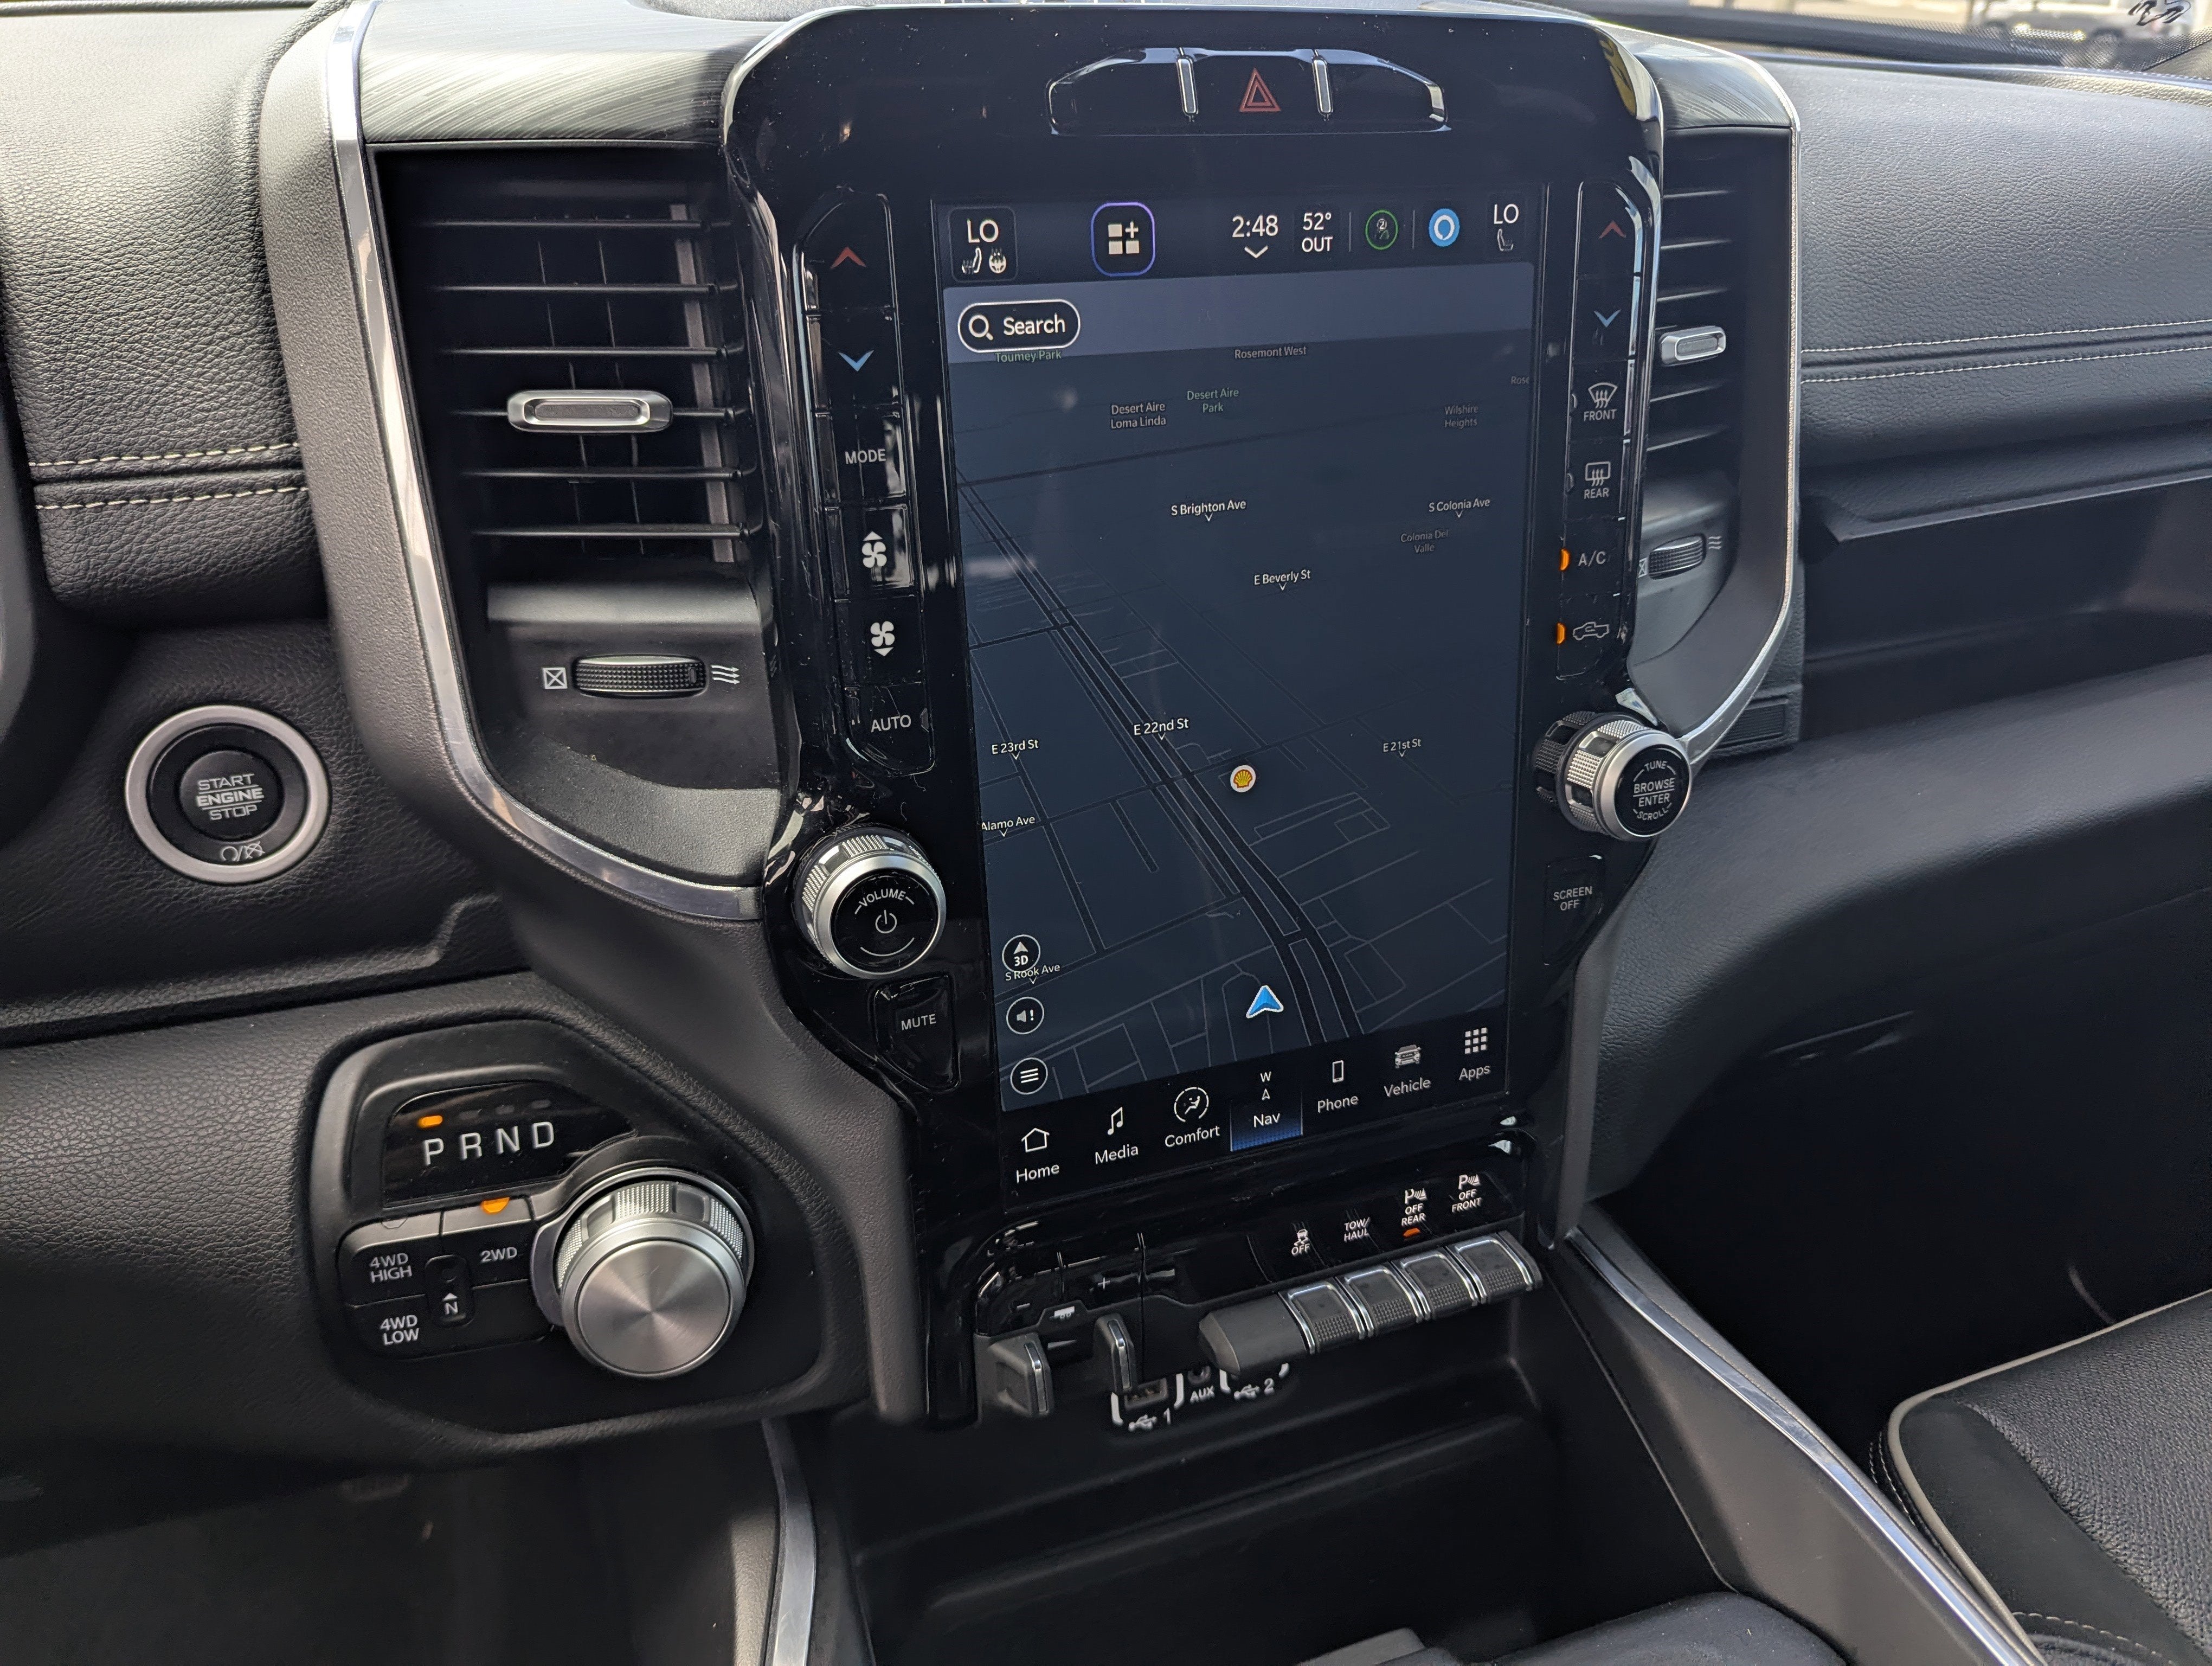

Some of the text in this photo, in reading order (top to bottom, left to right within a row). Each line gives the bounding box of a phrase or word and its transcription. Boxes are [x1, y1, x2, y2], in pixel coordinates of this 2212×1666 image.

[1494, 203, 1519, 224] LO
[967, 219, 999, 244] LO
[1232, 214, 1279, 238] 2:48
[1301, 236, 1333, 252] OUT
[1003, 313, 1066, 336] Search
[995, 349, 1062, 363] Toumey Park
[1234, 345, 1307, 360] Rosemont West
[1187, 388, 1239, 401] Desert Aire
[1111, 402, 1166, 415] Desert Aire
[1202, 402, 1224, 413] Park
[1444, 403, 1478, 415] Wilshire
[1583, 409, 1617, 422] FRONT
[1110, 415, 1166, 429] Loma Linda
[1444, 416, 1477, 429] Heights
[845, 448, 886, 464] MODE
[1584, 488, 1609, 499] REAR
[1171, 499, 1246, 516] S Brighton Ave
[1429, 497, 1490, 512] S Colonia Ave
[1400, 531, 1433, 543] Colonia
[1414, 543, 1435, 553] Valle
[1578, 550, 1606, 567] A/C
[1253, 569, 1311, 585] E Beverly St
[871, 714, 912, 733] AUTO
[1133, 717, 1189, 736] E 22nd St
[991, 739, 1039, 755] E 23rd St
[1382, 738, 1422, 752] E 21st St
[1644, 760, 1668, 771] TUNE
[198, 773, 254, 790] START
[1634, 777, 1675, 794] BROWSE
[196, 787, 265, 807] ENGINE
[1638, 793, 1670, 808] ENTER
[210, 804, 258, 821] STOP
[1636, 807, 1669, 821] SCROLL
[981, 815, 1035, 831] Alamo Ave
[858, 888, 906, 908] VOLUME
[1553, 886, 1592, 901] SCREEN
[1560, 899, 1579, 911] OFF
[1014, 955, 1028, 966] 3D
[1005, 964, 1060, 982] S Rook Ave
[901, 1014, 937, 1031] MUTE
[1260, 1071, 1272, 1082] W
[1459, 1065, 1491, 1081] Apps
[1384, 1078, 1431, 1098] Vehicle
[1317, 1094, 1359, 1113] Phone
[1253, 1112, 1281, 1128] Nav
[423, 1121, 555, 1165] P R N D
[1165, 1125, 1220, 1148] Comfort
[1095, 1144, 1139, 1164] Media
[1015, 1163, 1060, 1183] Home
[1458, 1189, 1477, 1201] OFF
[1405, 1203, 1424, 1215] OFF
[1451, 1197, 1483, 1213] FRONT
[1344, 1217, 1371, 1232] TOW/
[1401, 1213, 1426, 1227] REAR
[1344, 1228, 1369, 1242] HAUL
[480, 1247, 518, 1264] 2WD
[1291, 1243, 1310, 1256] OFF
[370, 1253, 409, 1270] 4WD
[370, 1266, 413, 1283] HIGH
[445, 1301, 458, 1315] N
[381, 1314, 418, 1331] 4WD
[383, 1328, 419, 1346] LOW
[1264, 1377, 1275, 1394] 2
[1190, 1385, 1215, 1404] AUX
[1163, 1407, 1171, 1425] 1
